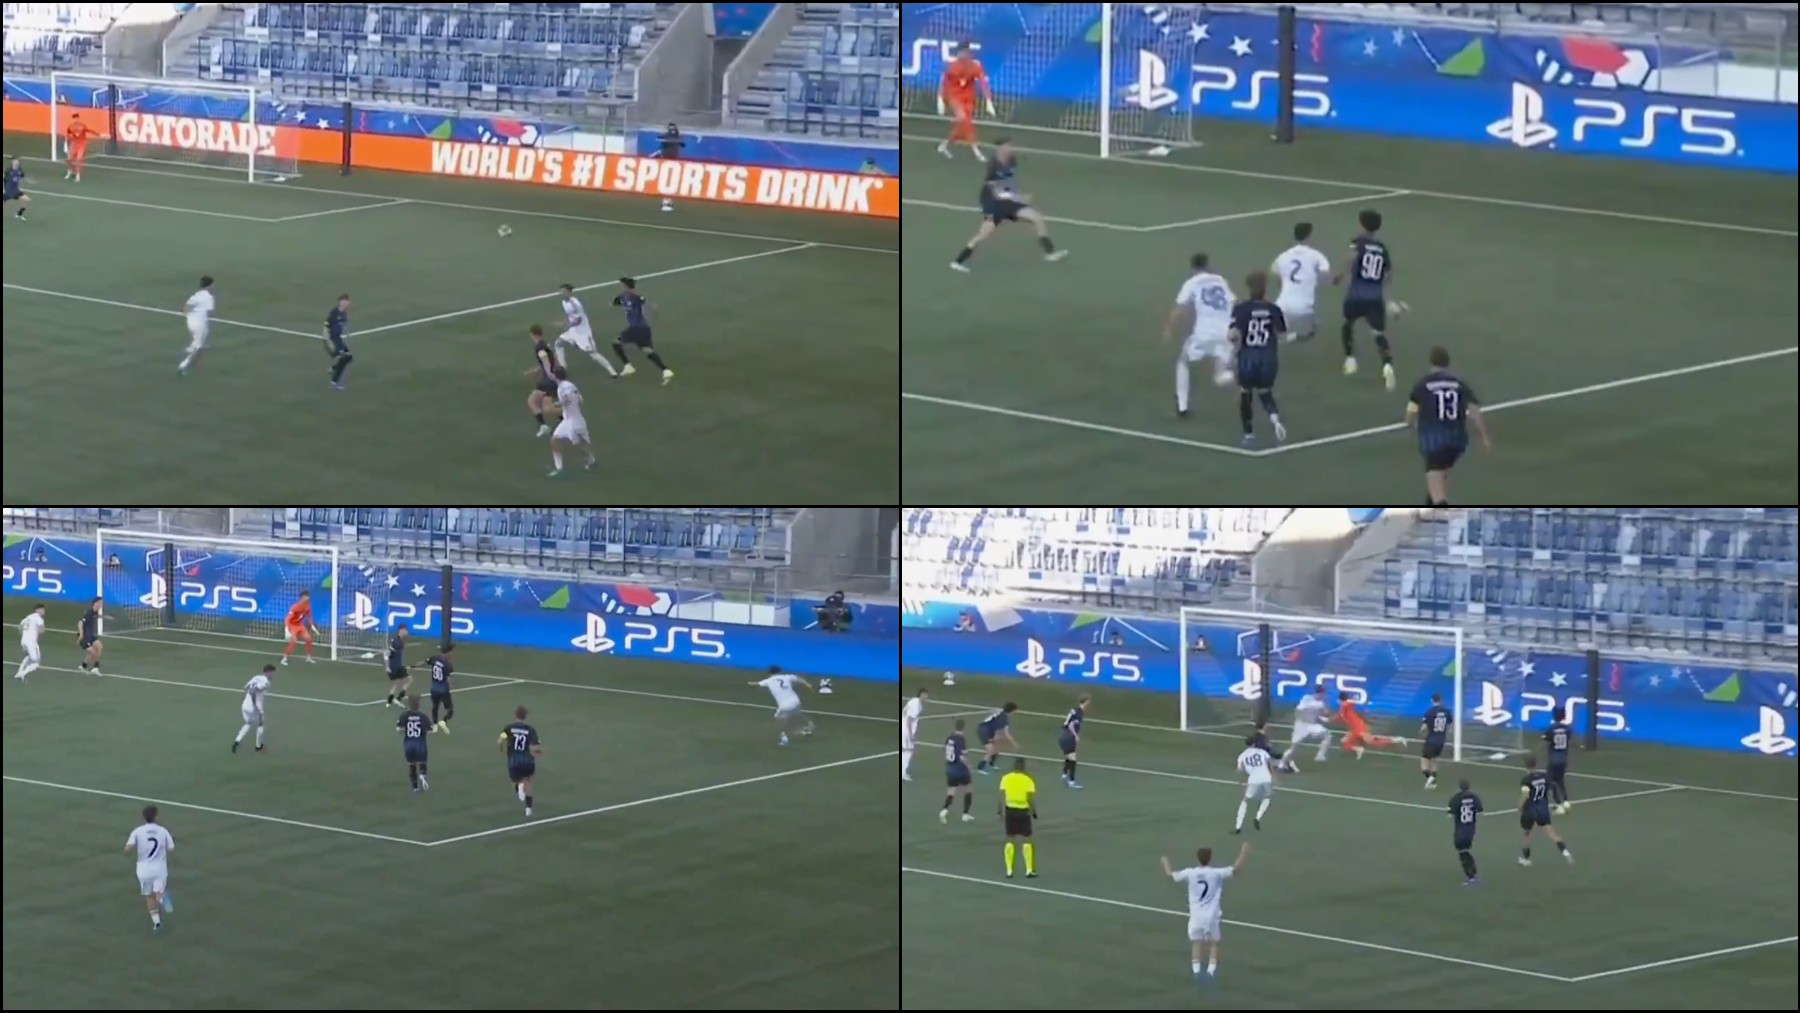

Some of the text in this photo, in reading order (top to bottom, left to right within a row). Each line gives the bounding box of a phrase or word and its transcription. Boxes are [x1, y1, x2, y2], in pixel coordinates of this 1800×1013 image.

[118, 112, 276, 156] GATORADE
[1573, 98, 1736, 156] PS5
[431, 140, 564, 185] WORLD'S
[571, 153, 606, 188] #1
[613, 156, 749, 202] SPORTS
[1290, 258, 1302, 284] 2
[1361, 252, 1384, 280] 90
[1246, 319, 1270, 346] 85
[181, 581, 257, 613] PS5
[624, 621, 725, 658] PS5
[1059, 648, 1141, 682] PS5
[406, 721, 421, 738] 85
[1244, 753, 1263, 768] 48
[147, 837, 159, 859] 7
[1197, 879, 1209, 901] 7
